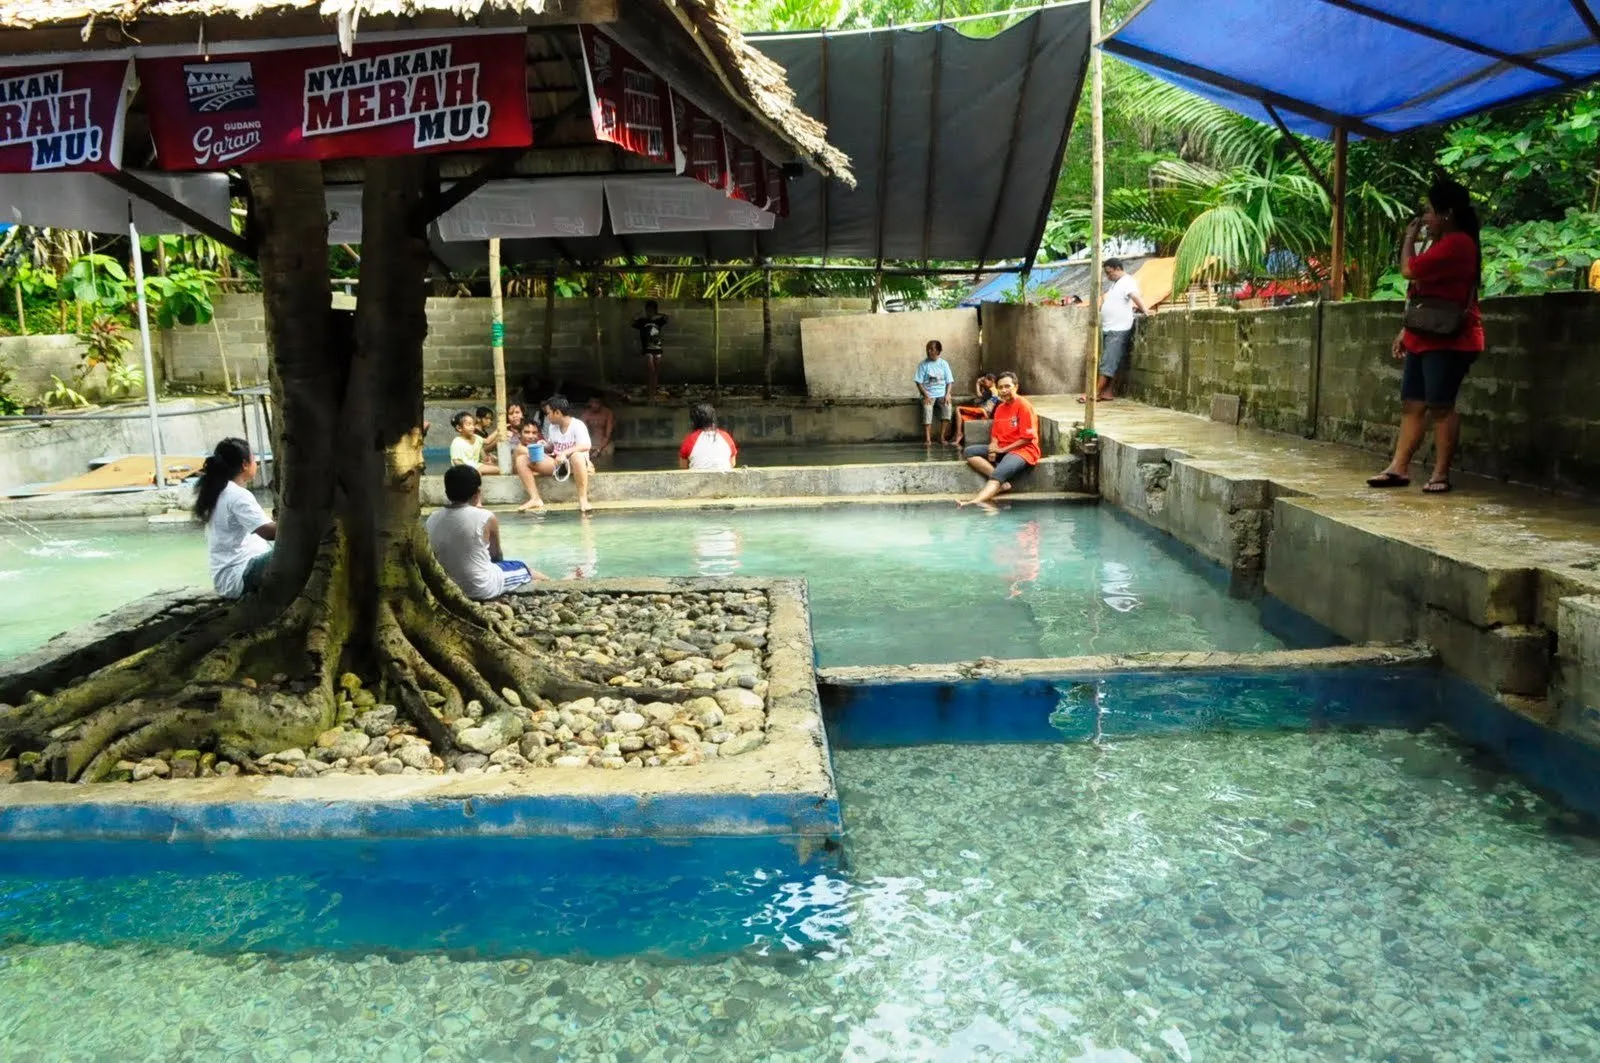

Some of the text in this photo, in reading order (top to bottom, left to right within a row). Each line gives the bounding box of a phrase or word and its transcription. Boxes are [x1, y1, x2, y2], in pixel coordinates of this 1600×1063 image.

[307, 48, 448, 93] NYALAKAN
[306, 68, 477, 132] MERAH
[224, 121, 262, 132] GUDANG
[418, 104, 488, 143] MU!
[36, 129, 100, 165] MU!
[192, 125, 262, 164] Garam
